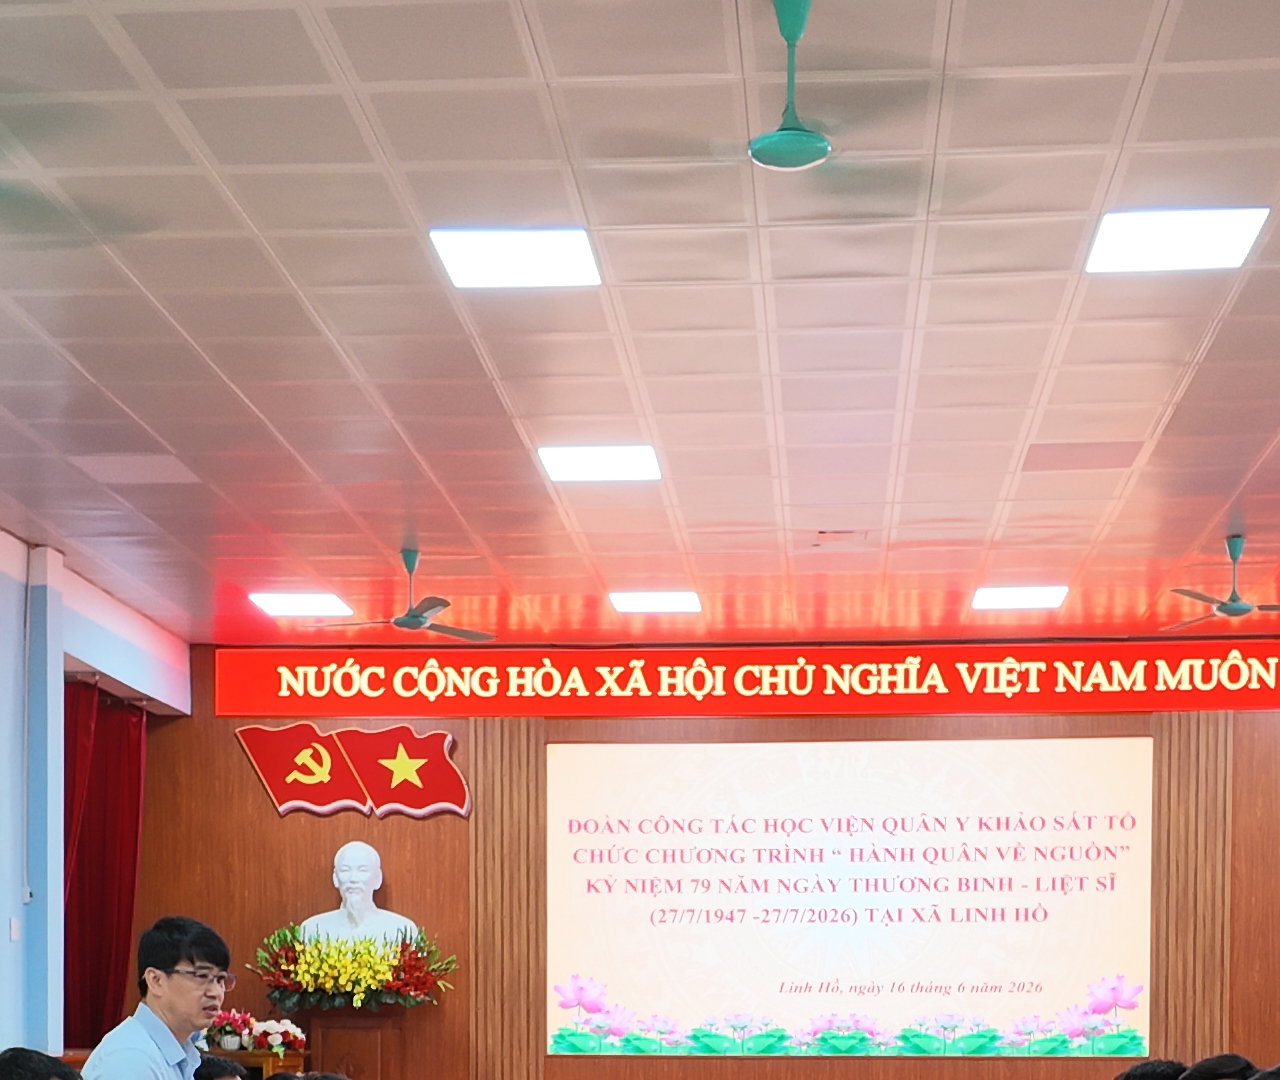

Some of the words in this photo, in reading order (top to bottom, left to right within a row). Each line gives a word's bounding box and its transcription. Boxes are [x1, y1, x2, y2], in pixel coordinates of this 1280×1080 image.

[277, 658, 385, 697] NƯỚC
[393, 658, 500, 701] CỘNG
[506, 658, 589, 697] HÒA
[595, 660, 652, 696] XÃ
[658, 658, 726, 700] HỘI
[734, 657, 815, 696] CHỦ
[823, 656, 948, 694] NGHĨA
[956, 657, 1046, 698] VIỆT
[1054, 660, 1147, 692] NAM
[1155, 650, 1278, 690] MUÔN
[568, 815, 630, 834] ĐOÀN
[638, 815, 703, 834] CÔNG
[710, 814, 756, 833] TÁC
[764, 818, 812, 837] HỌC
[820, 815, 874, 837] VIỆN
[882, 813, 946, 836] QUÂN
[956, 817, 969, 831] Y
[978, 812, 1046, 831] KHẢO
[1053, 811, 1097, 831] SÁT
[573, 845, 638, 864] CHỨC
[645, 847, 745, 863] CHƯƠNG
[753, 844, 823, 863] TRÌNH
[850, 843, 915, 862] HÀNH
[922, 843, 987, 865] QUÂN
[625, 877, 683, 897] NIỆM
[691, 879, 711, 893] 79
[719, 875, 769, 893] NĂM
[778, 874, 841, 893] NGÀY
[849, 875, 949, 892] THƯƠNG
[958, 877, 1012, 892] BINH
[1036, 875, 1089, 895] LIỆT
[1096, 872, 1116, 891] SĨ
[650, 909, 746, 926] (27/7/1947
[865, 908, 902, 927] TẠI
[911, 904, 941, 922] XÃ
[951, 908, 1006, 922] LINH
[779, 982, 812, 993] Linh
[849, 981, 883, 996] ngày
[890, 982, 905, 993] 16
[911, 981, 952, 996] tháng
[958, 983, 965, 992] 6
[971, 983, 1002, 993] năm
[1008, 982, 1042, 993] 2026
